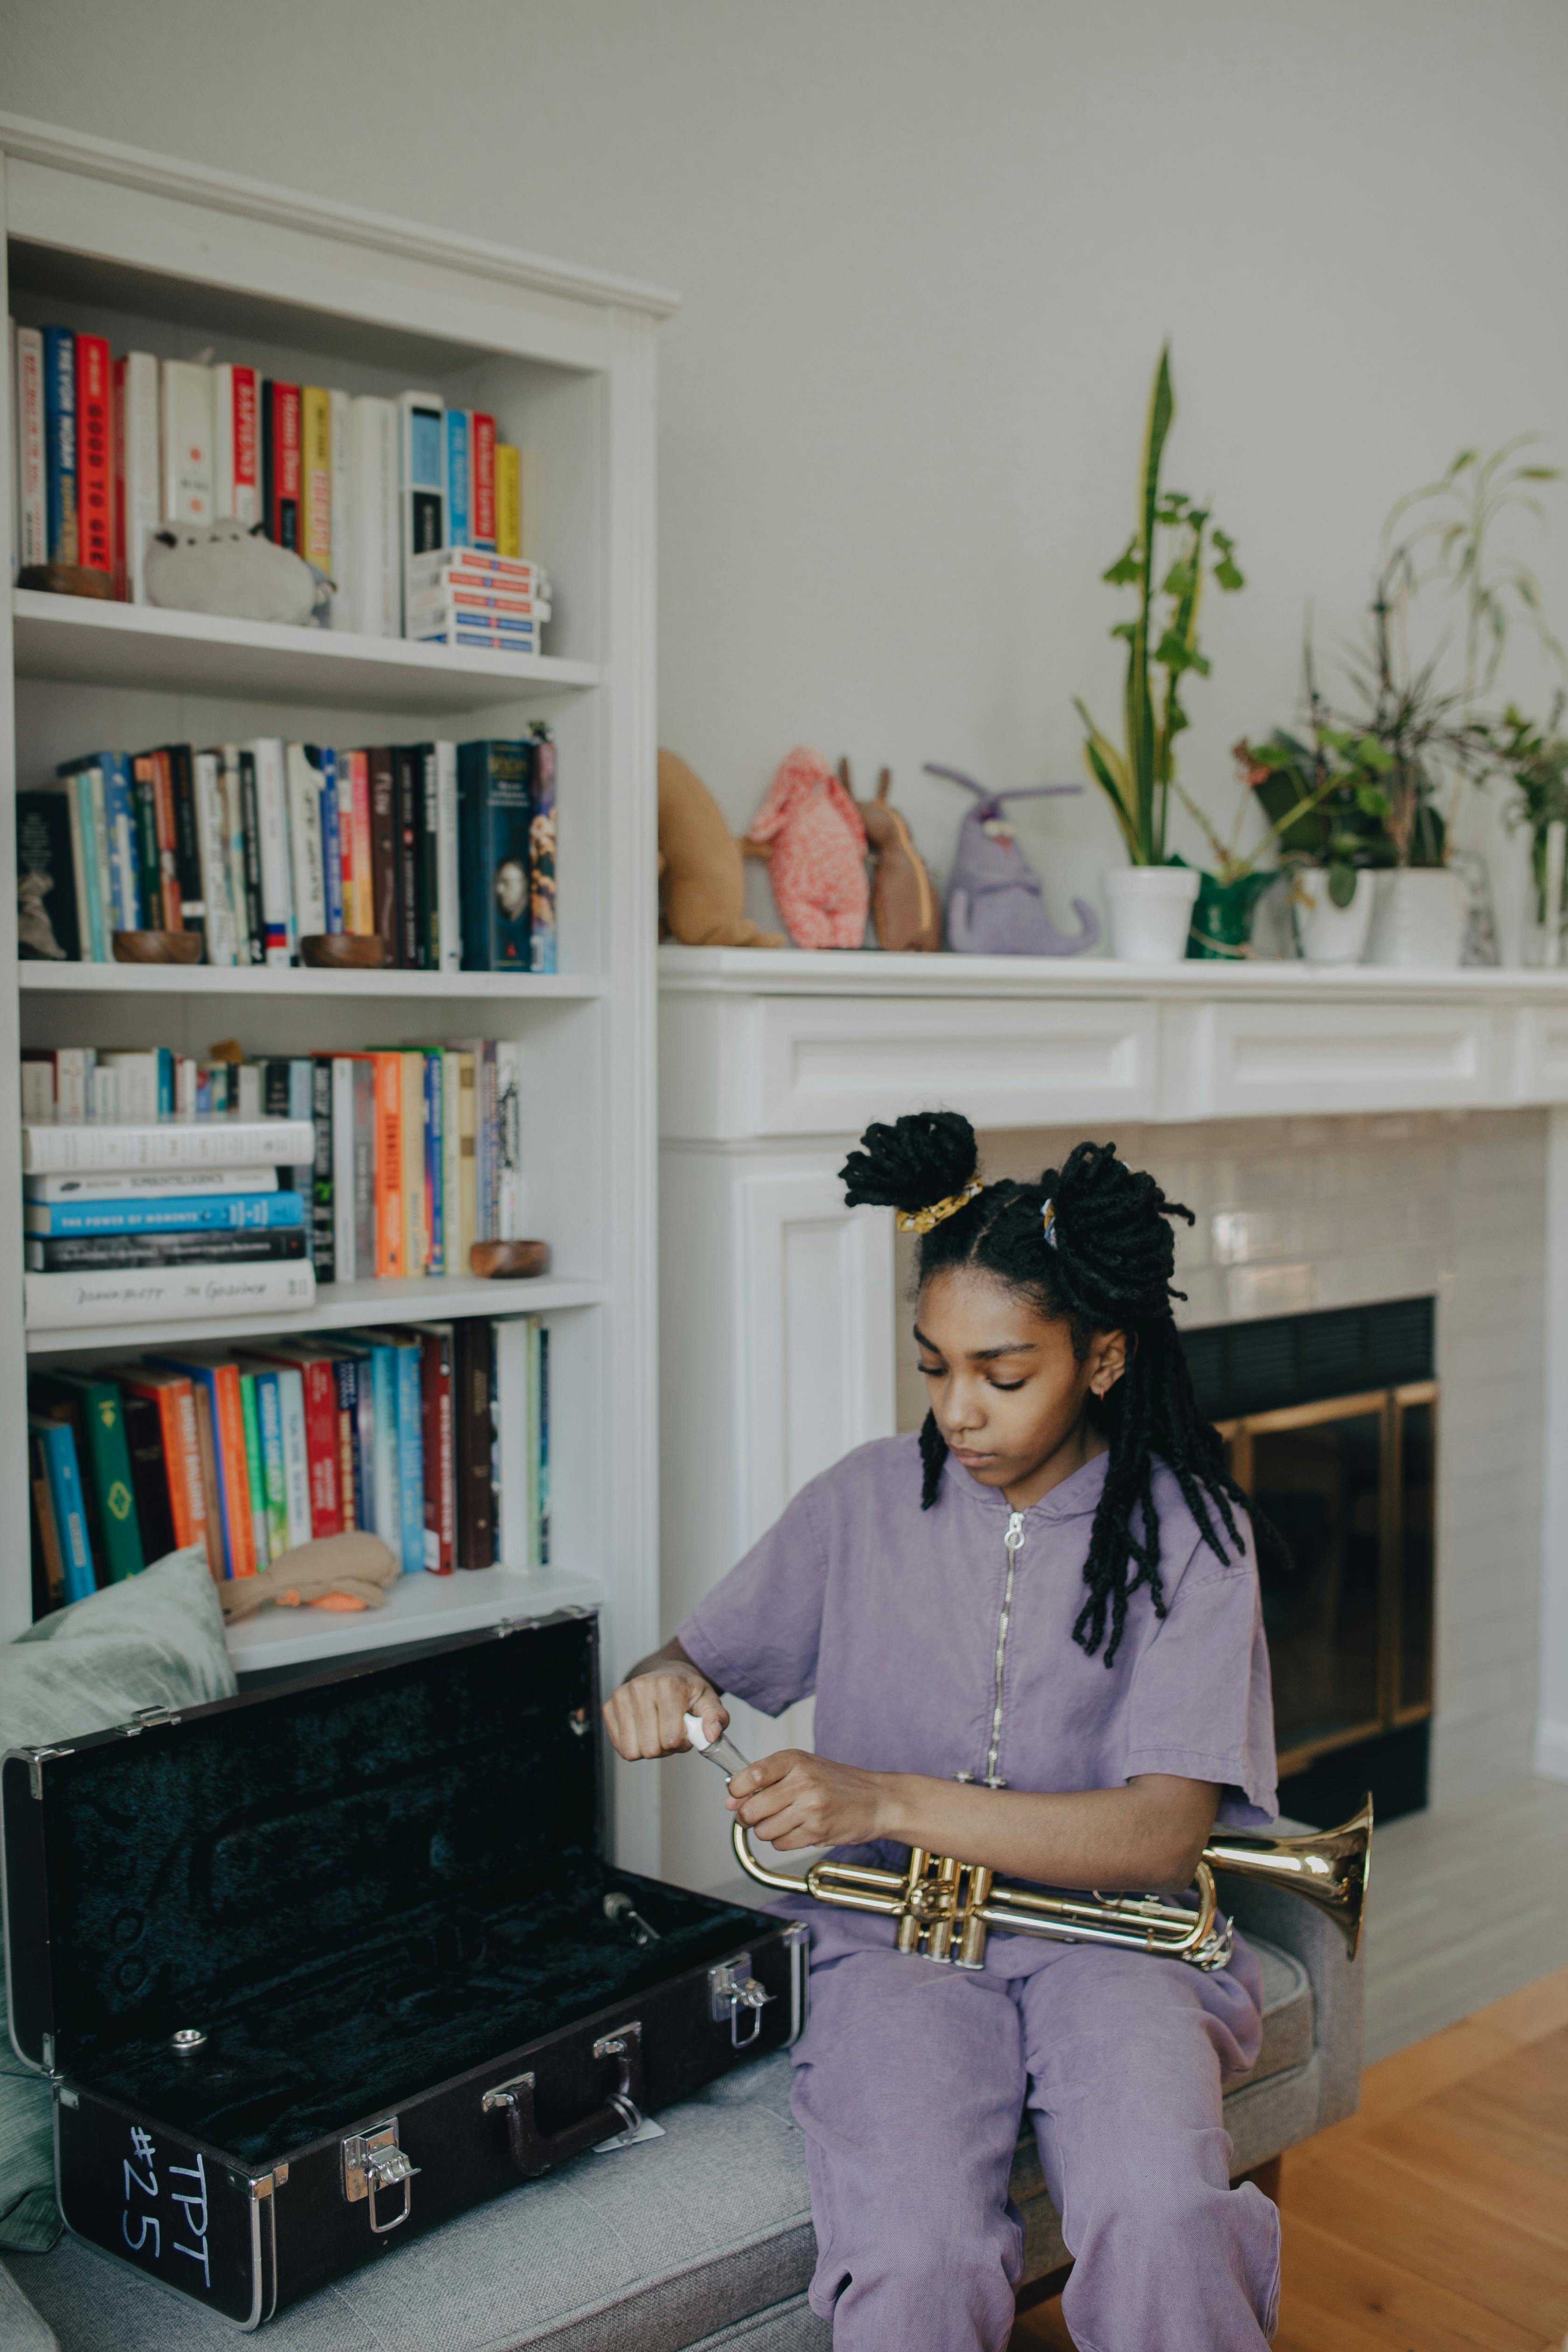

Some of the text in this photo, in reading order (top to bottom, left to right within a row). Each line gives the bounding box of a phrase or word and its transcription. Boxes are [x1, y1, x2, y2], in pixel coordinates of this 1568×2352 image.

[56, 338, 74, 412] TREVOR
[61, 414, 75, 469] NOAH
[87, 404, 105, 565] GOOD TO GRE
[62, 1212, 198, 1228] THE POWER OF MOMENTS
[169, 2153, 211, 2289] TPT
